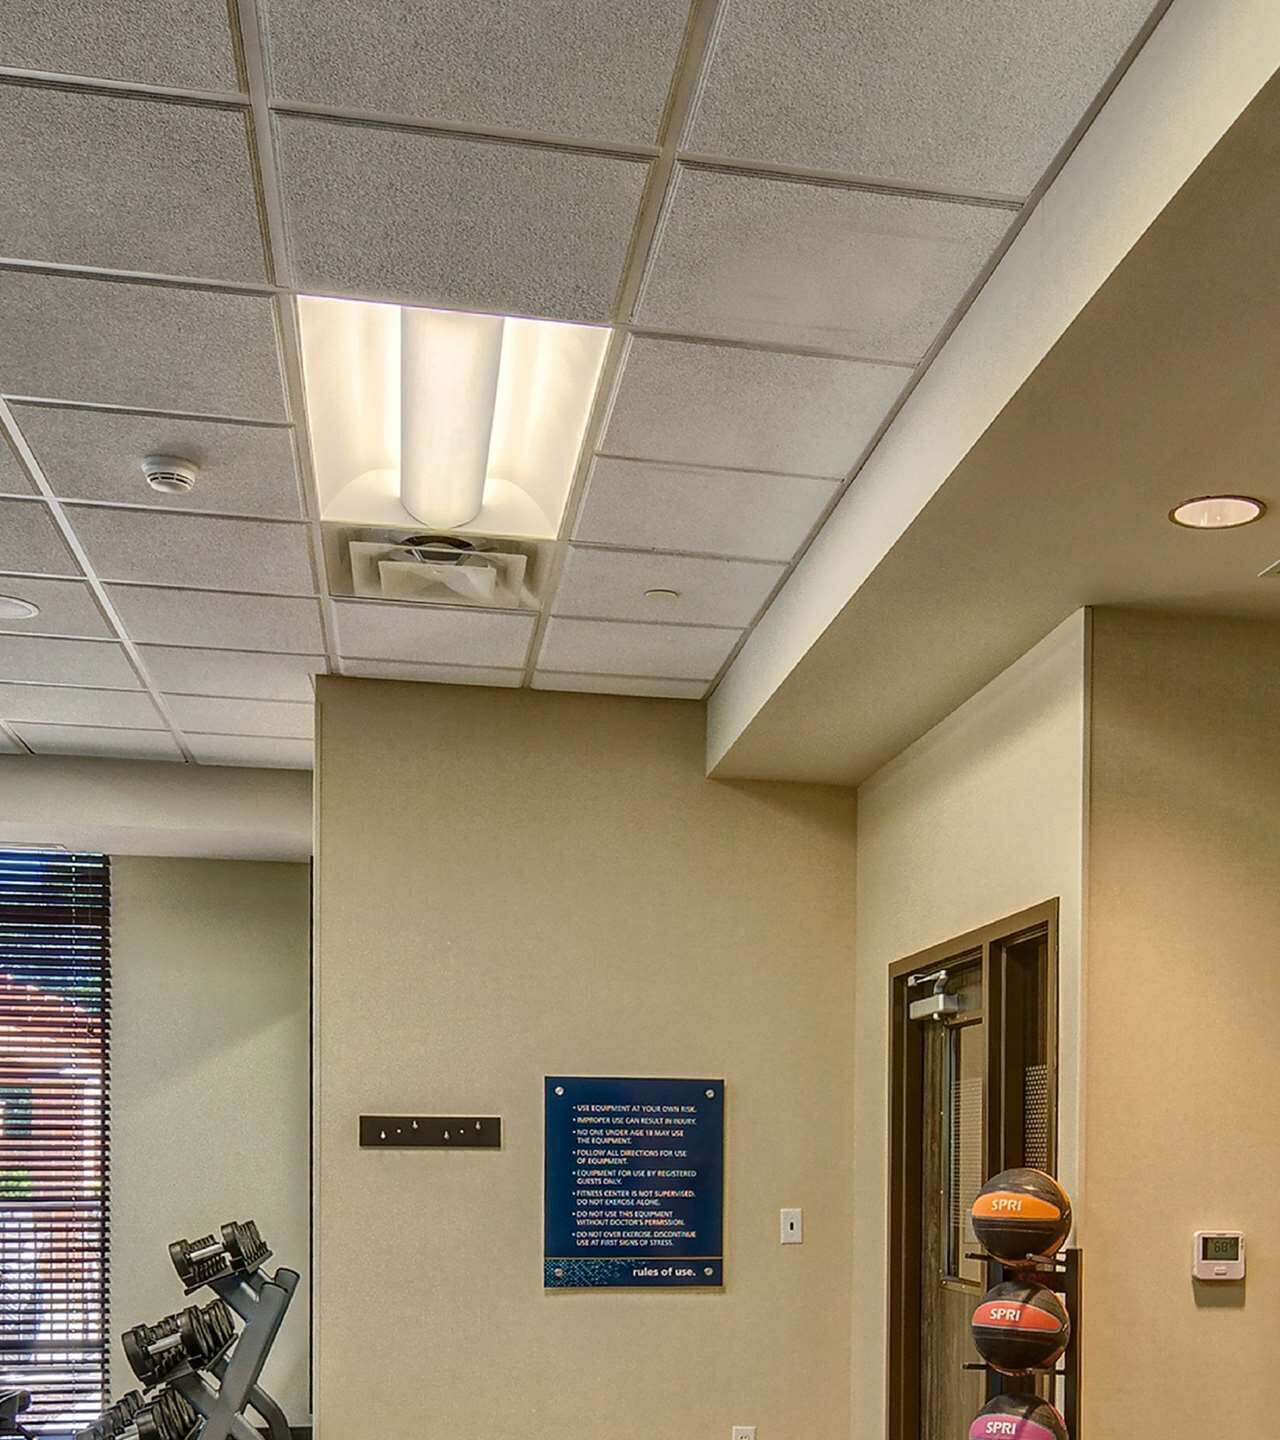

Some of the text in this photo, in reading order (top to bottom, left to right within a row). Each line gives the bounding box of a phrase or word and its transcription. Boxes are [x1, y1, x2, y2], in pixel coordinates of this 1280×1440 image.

[991, 1199, 1021, 1211] SPRI
[633, 1267, 658, 1276] rules
[661, 1267, 673, 1276] of
[989, 1308, 1020, 1321] SPRI
[985, 1421, 1016, 1435] SPRI
